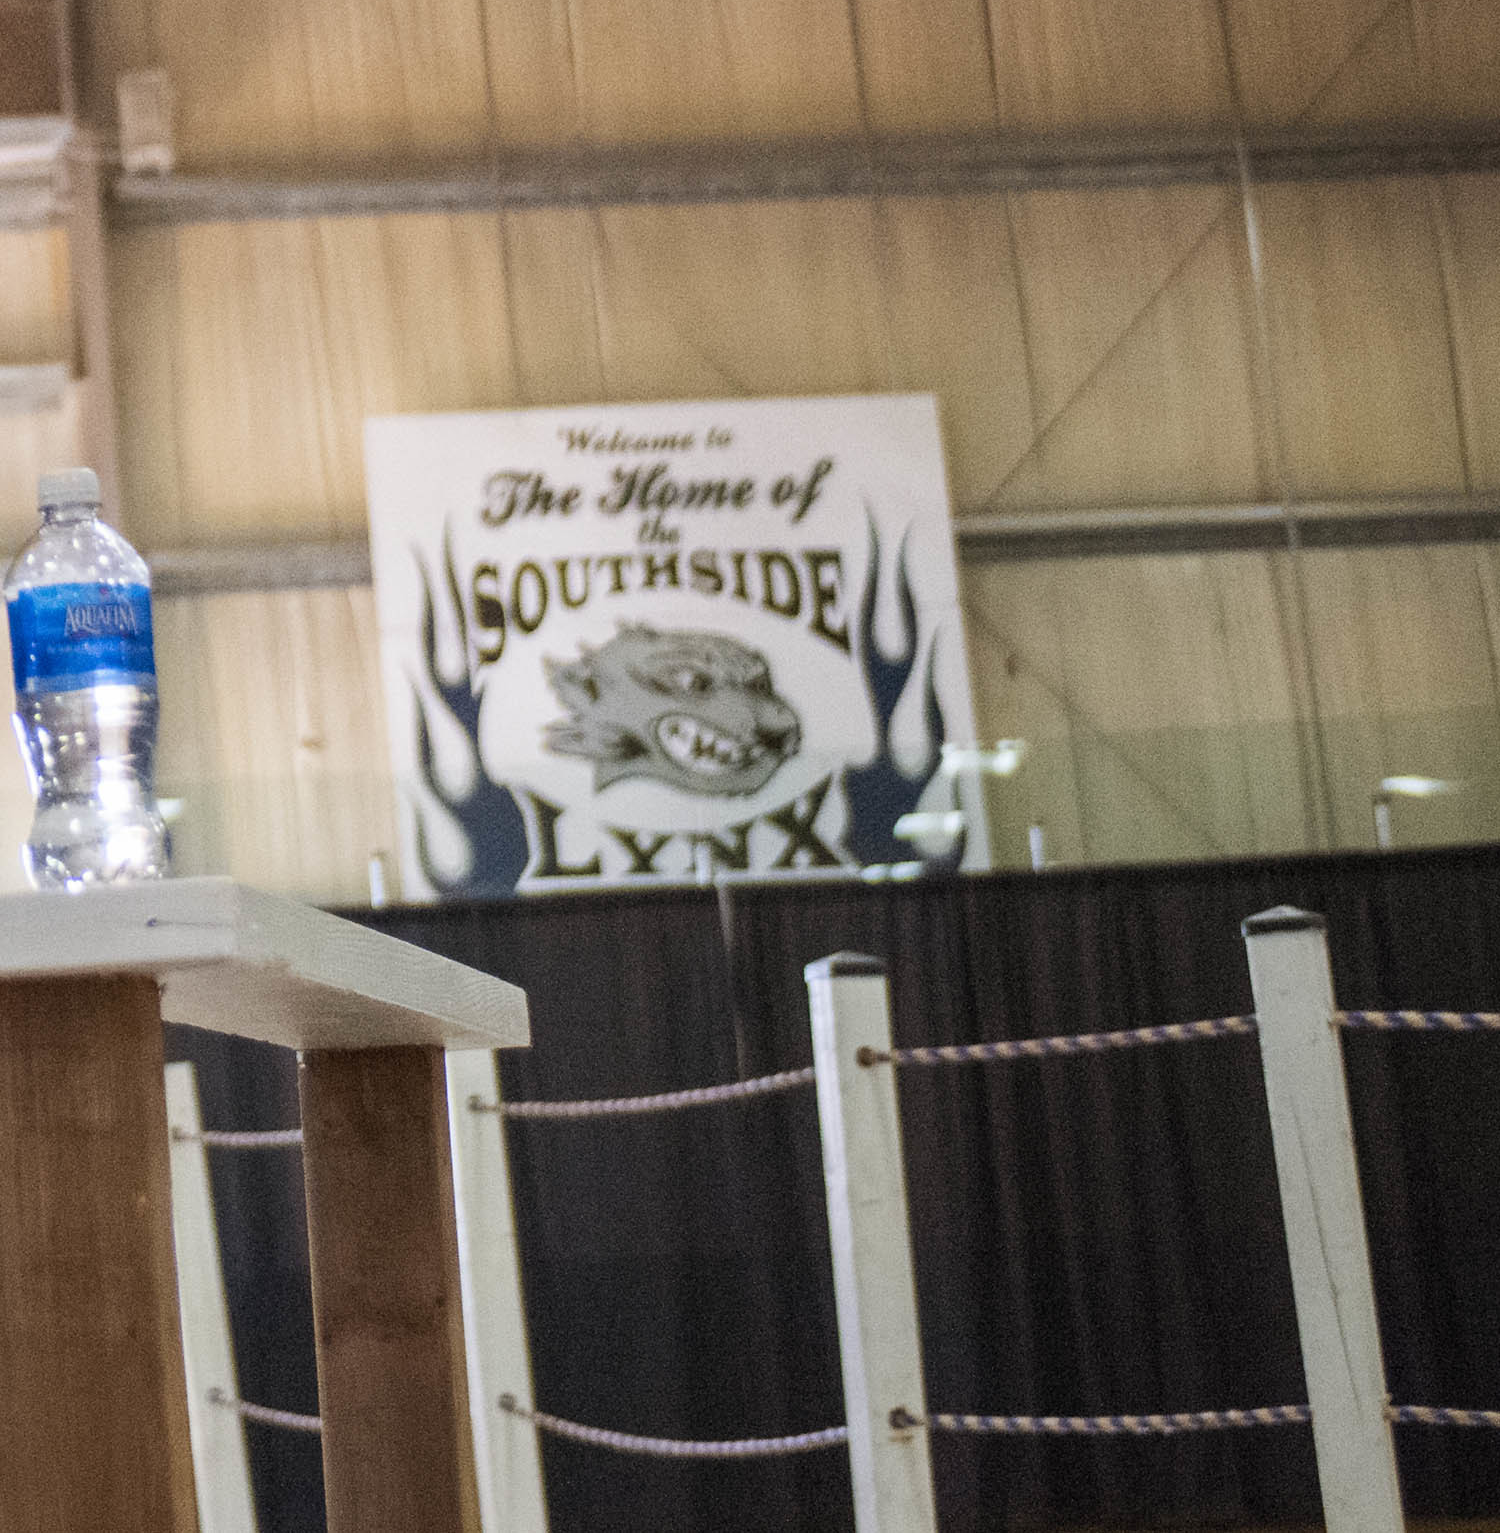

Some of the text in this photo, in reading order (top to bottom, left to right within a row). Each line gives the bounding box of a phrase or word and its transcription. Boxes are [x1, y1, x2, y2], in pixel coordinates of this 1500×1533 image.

[559, 426, 733, 452] Welcome to
[480, 456, 834, 526] The Home of
[637, 516, 681, 545] the
[64, 601, 137, 637] AQUAFINA
[472, 549, 851, 665] SOUTHSIDE
[526, 771, 843, 877] LYNX
